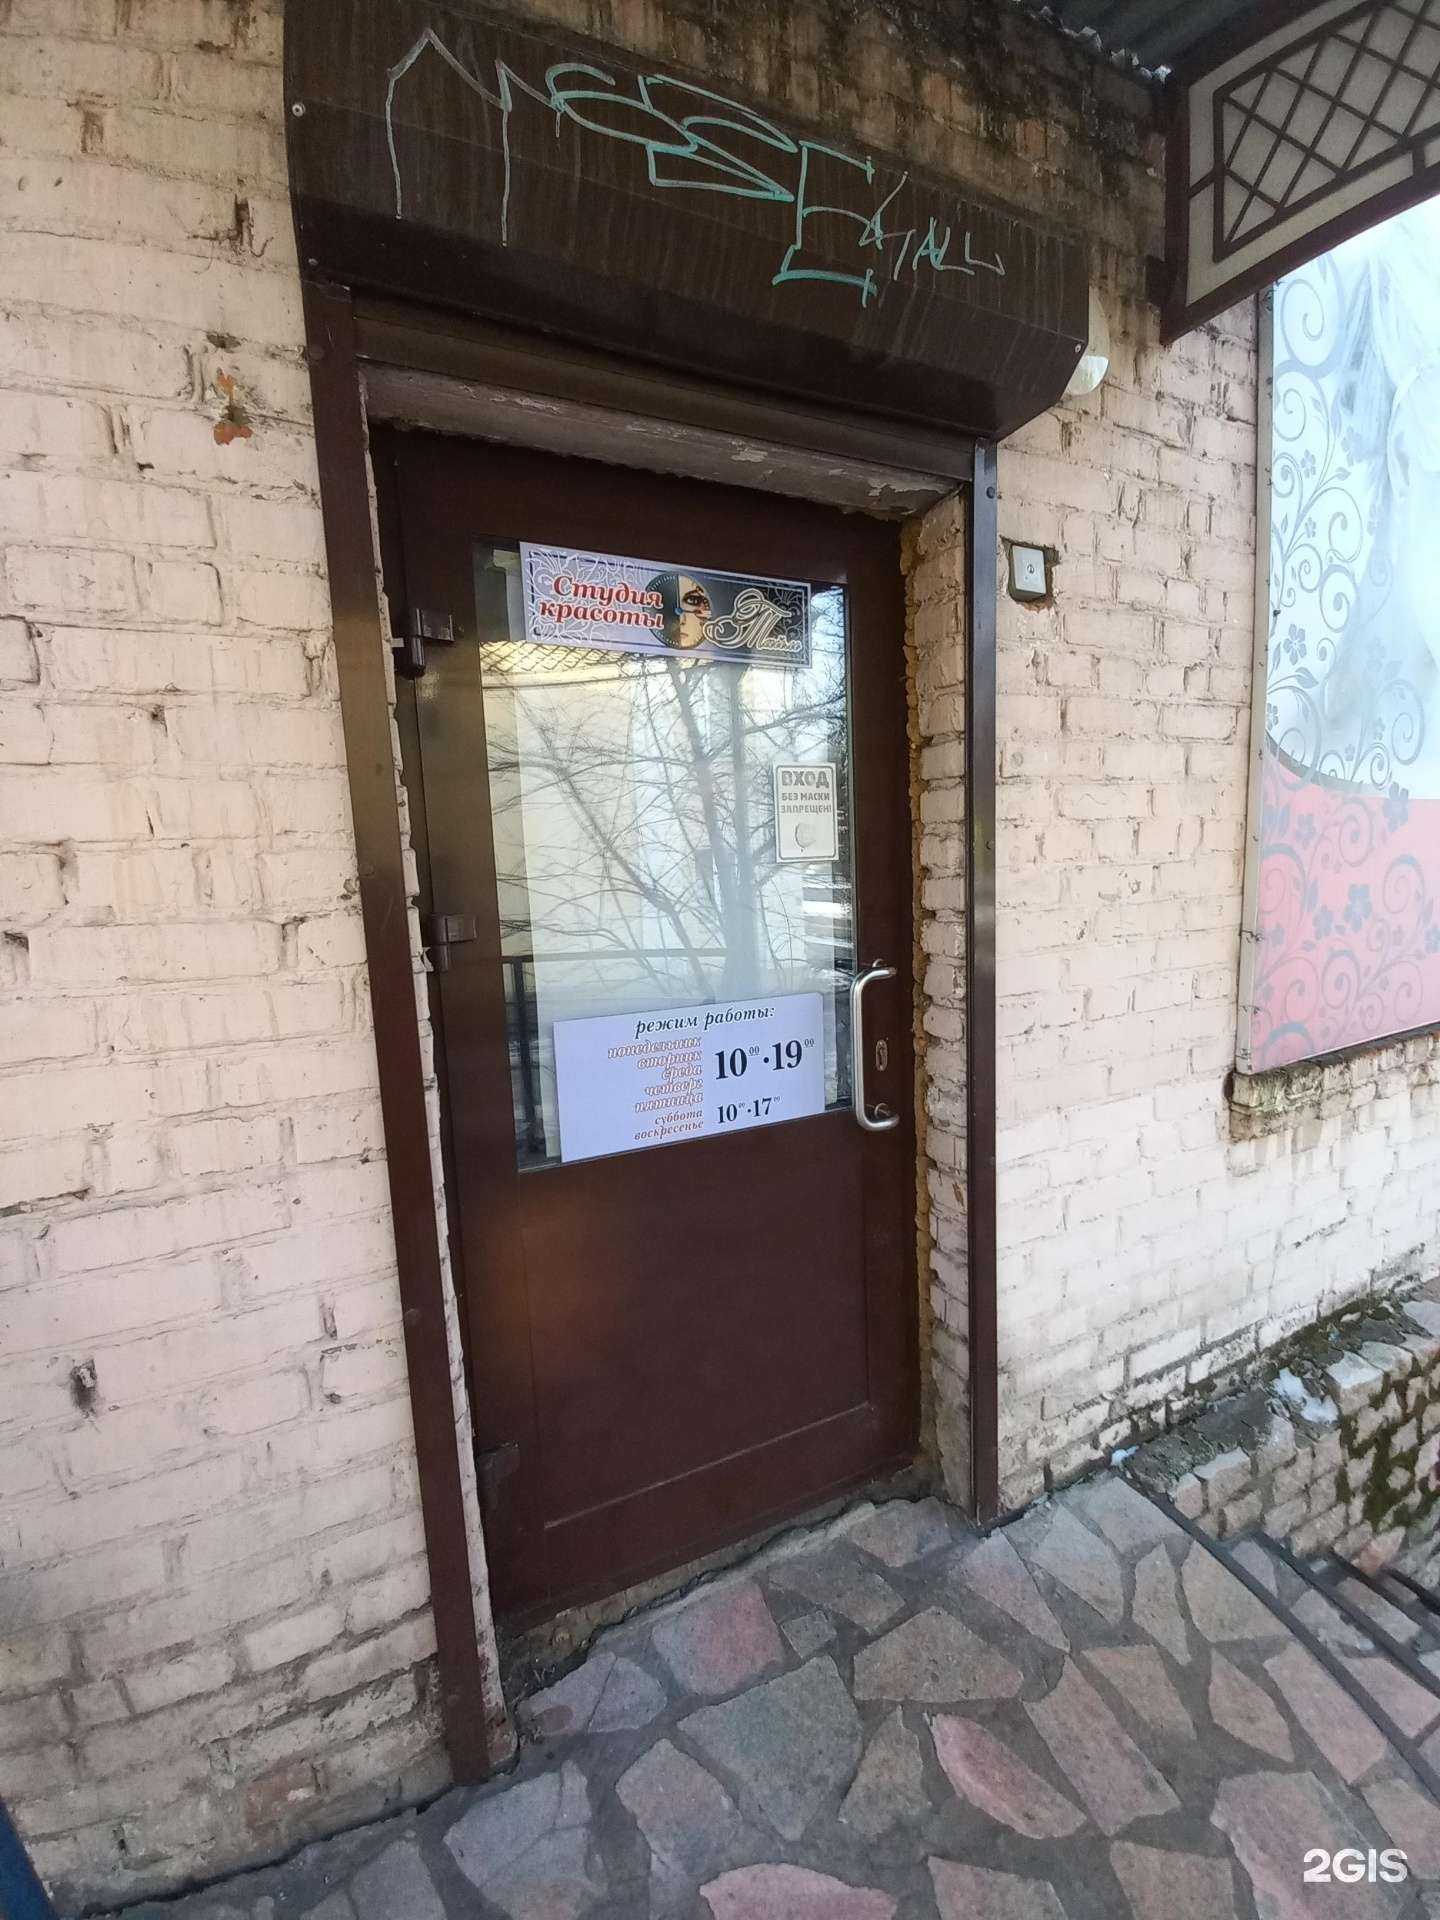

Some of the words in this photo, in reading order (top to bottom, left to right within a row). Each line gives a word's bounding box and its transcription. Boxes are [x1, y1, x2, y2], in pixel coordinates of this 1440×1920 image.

[553, 575, 664, 607] Студия
[539, 599, 665, 630] красоты
[781, 770, 830, 789] ВХОД
[781, 792, 799, 801] БЕЗ
[800, 792, 831, 801] МАСКИ
[634, 1015, 698, 1039] режим
[703, 1006, 775, 1031] работы:
[661, 1065, 703, 1083] среда
[654, 1109, 703, 1126] суббота
